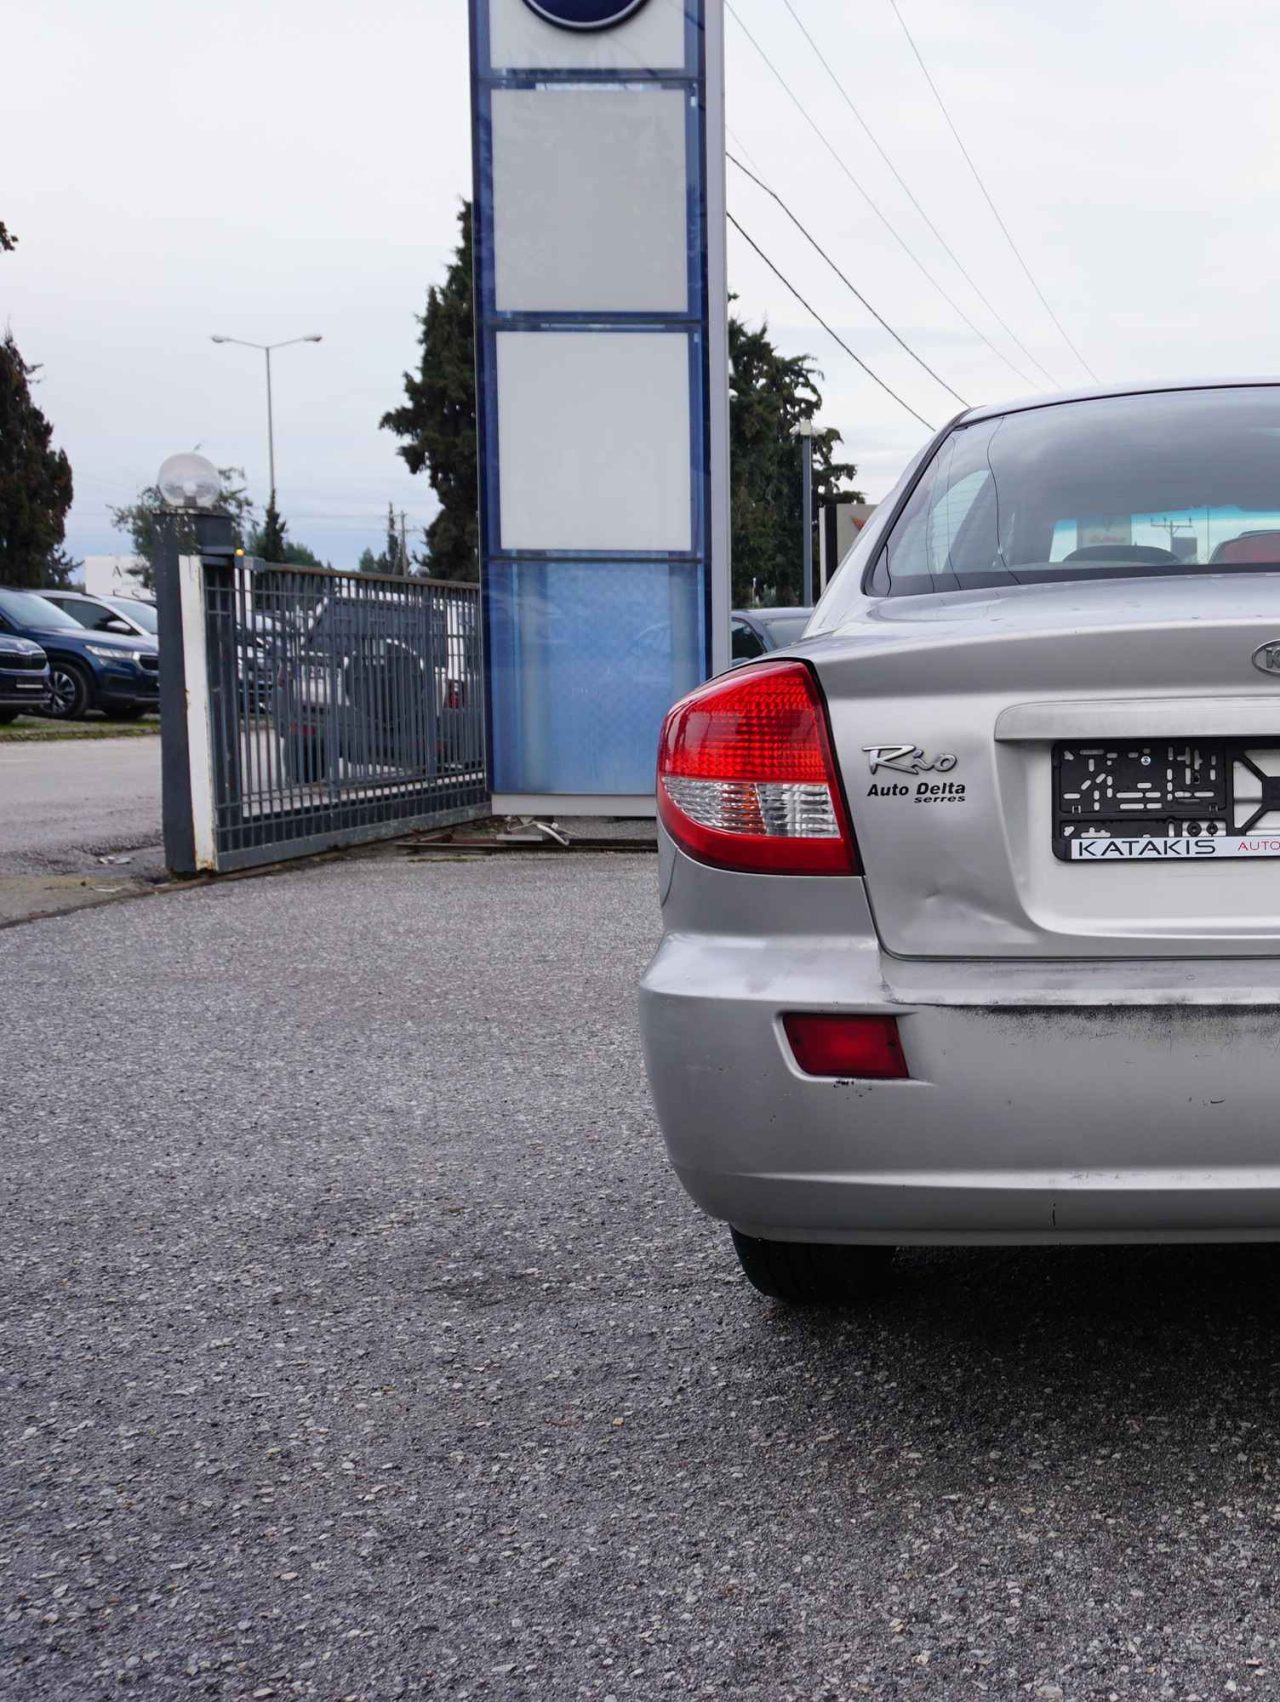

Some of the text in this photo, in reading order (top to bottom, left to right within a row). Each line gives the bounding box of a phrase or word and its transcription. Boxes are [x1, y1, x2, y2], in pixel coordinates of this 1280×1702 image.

[862, 744, 958, 775] Rio
[867, 781, 966, 797] Auto Delta
[913, 795, 966, 804] serres
[1079, 839, 1216, 857] KATAKIS
[1237, 841, 1280, 852] AUTO
